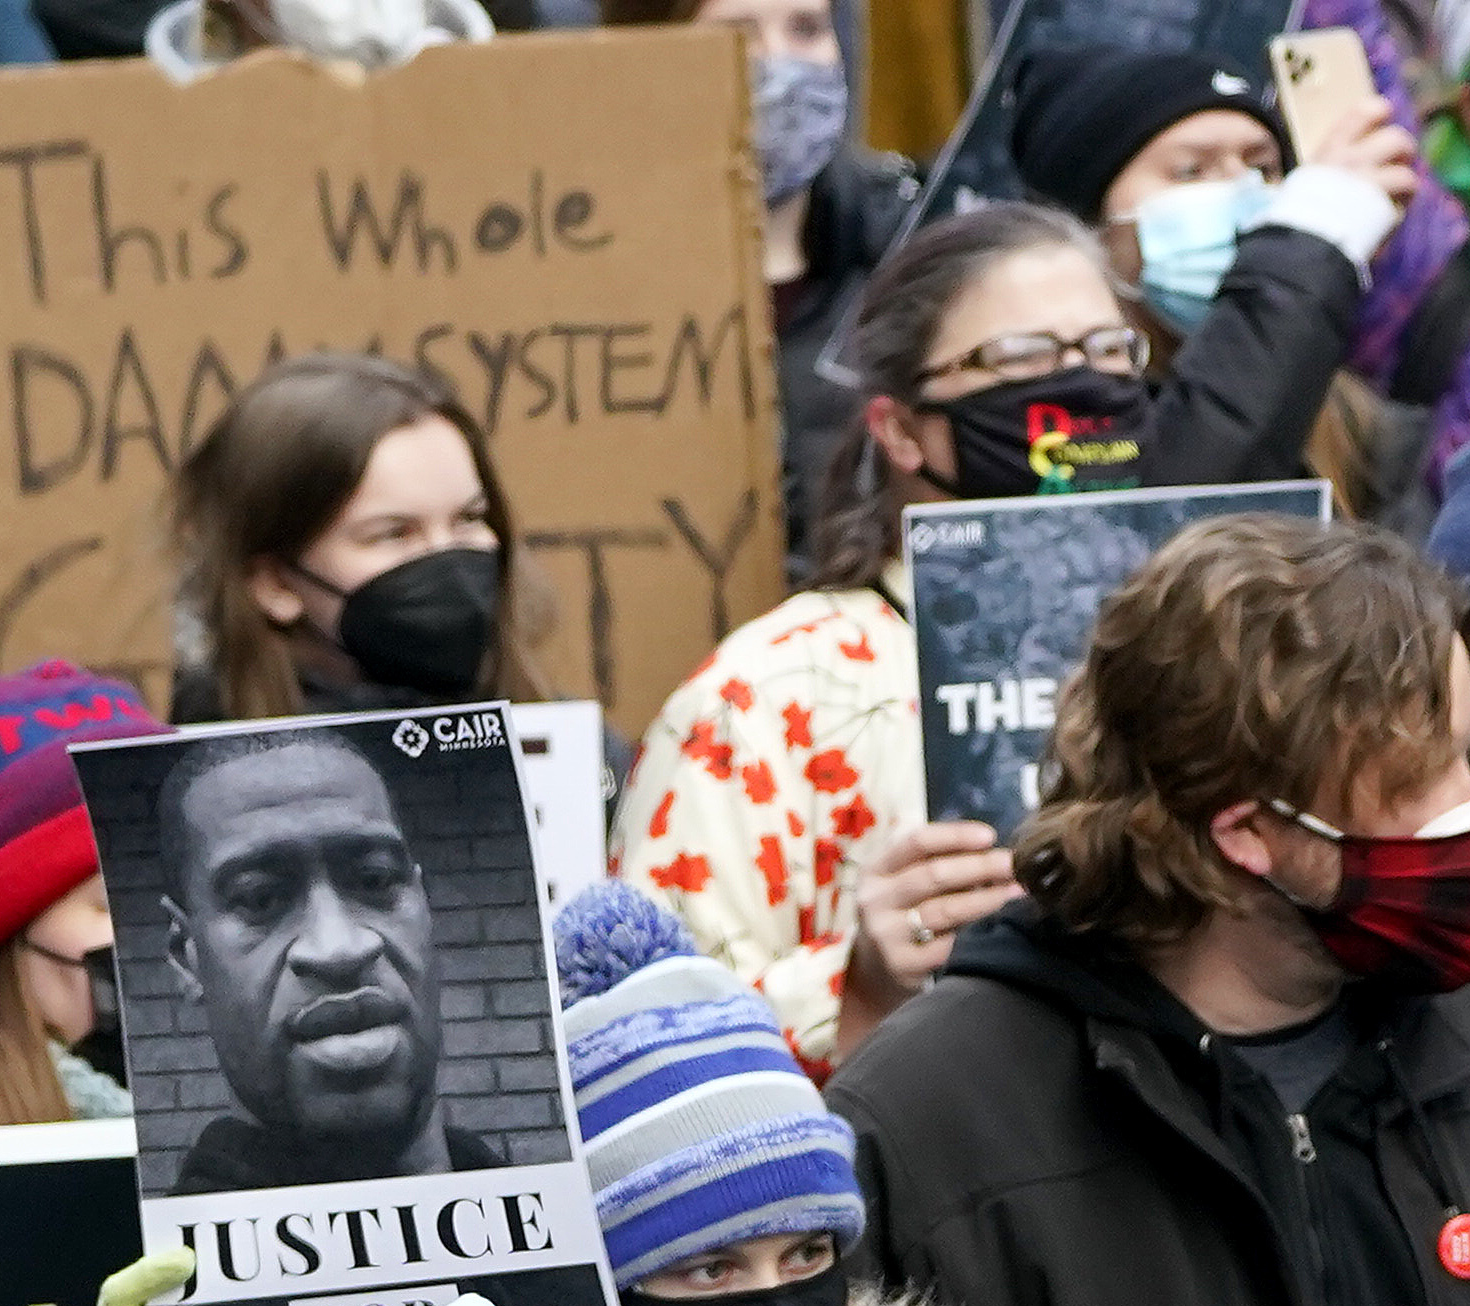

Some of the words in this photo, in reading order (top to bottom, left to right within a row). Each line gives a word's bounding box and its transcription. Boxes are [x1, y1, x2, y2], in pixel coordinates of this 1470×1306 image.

[315, 165, 616, 280] Whole
[413, 302, 760, 438] SYSTEM
[433, 712, 502, 744] CAIR
[439, 736, 507, 752] MINNESOTA
[937, 677, 1059, 736] THE
[173, 1191, 555, 1304] JUSTICE
